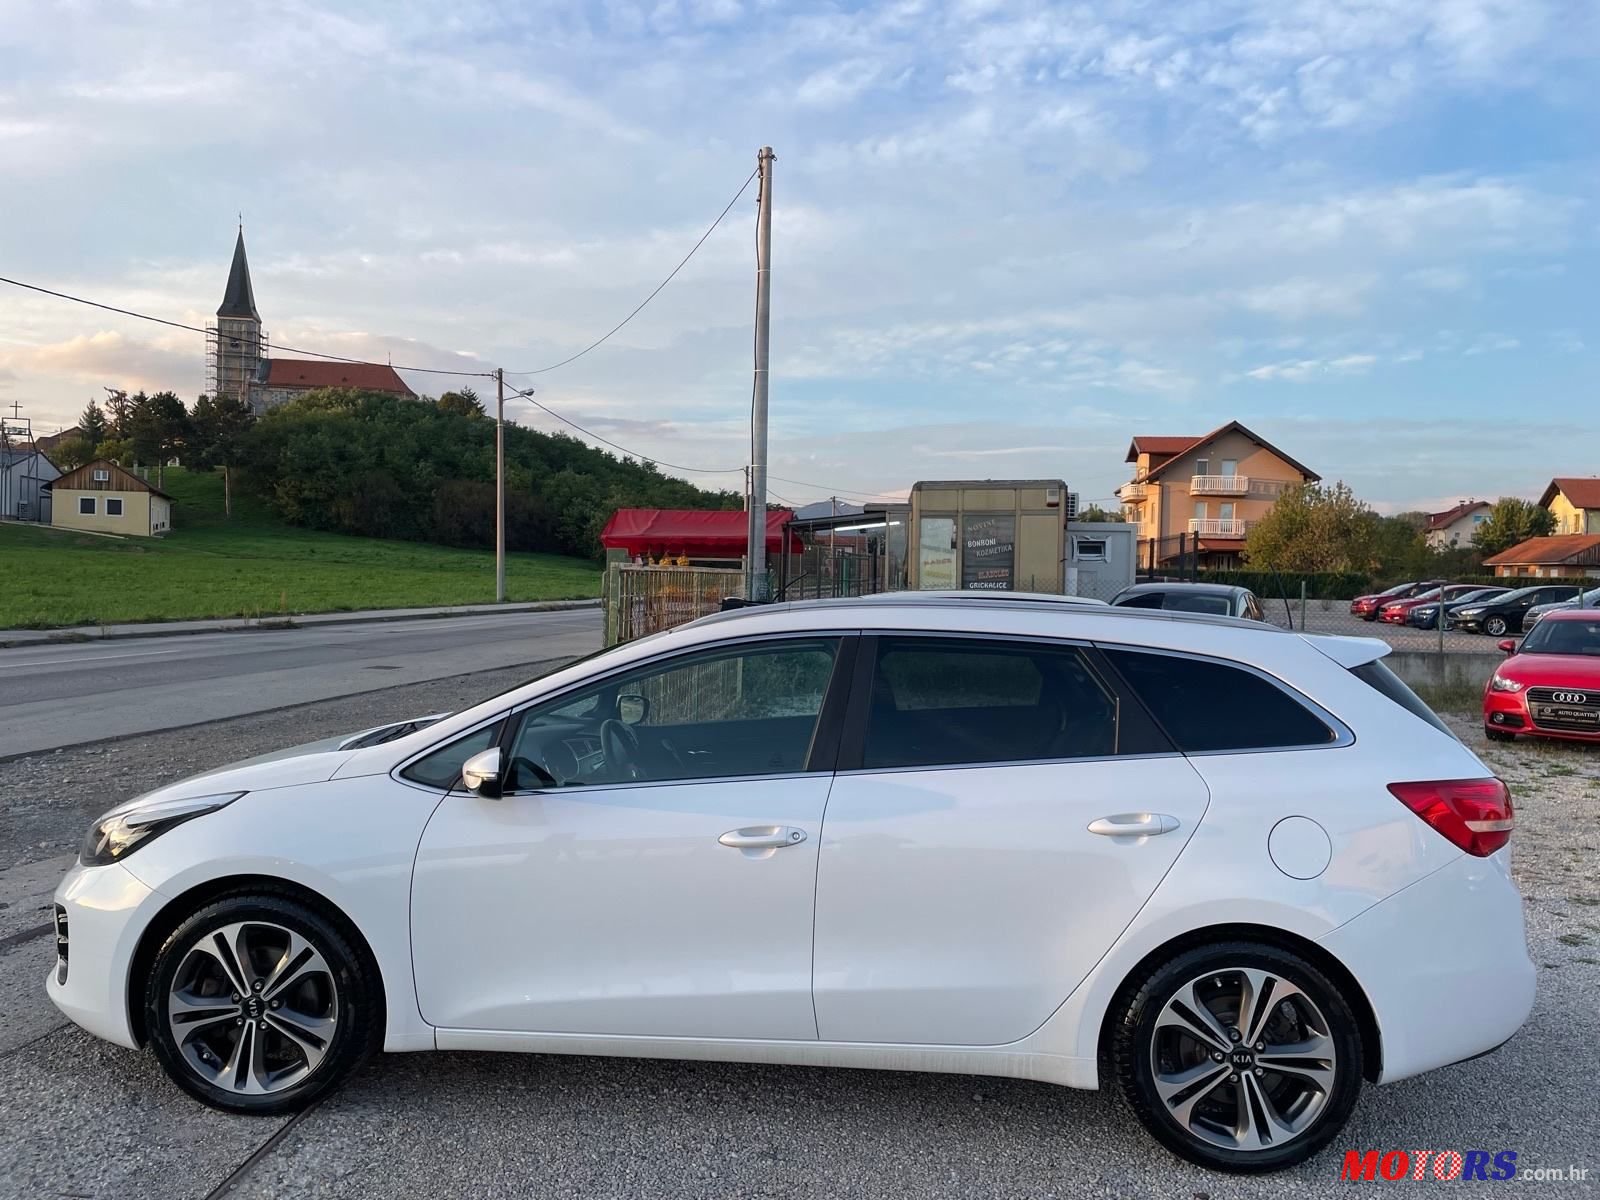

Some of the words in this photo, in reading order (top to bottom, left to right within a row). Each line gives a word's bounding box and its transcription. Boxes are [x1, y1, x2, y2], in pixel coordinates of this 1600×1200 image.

[968, 538, 996, 547] BONBONI
[976, 544, 1013, 557] KOZMETIKA
[249, 998, 259, 1017] KIA
[1233, 1055, 1252, 1063] KIA
